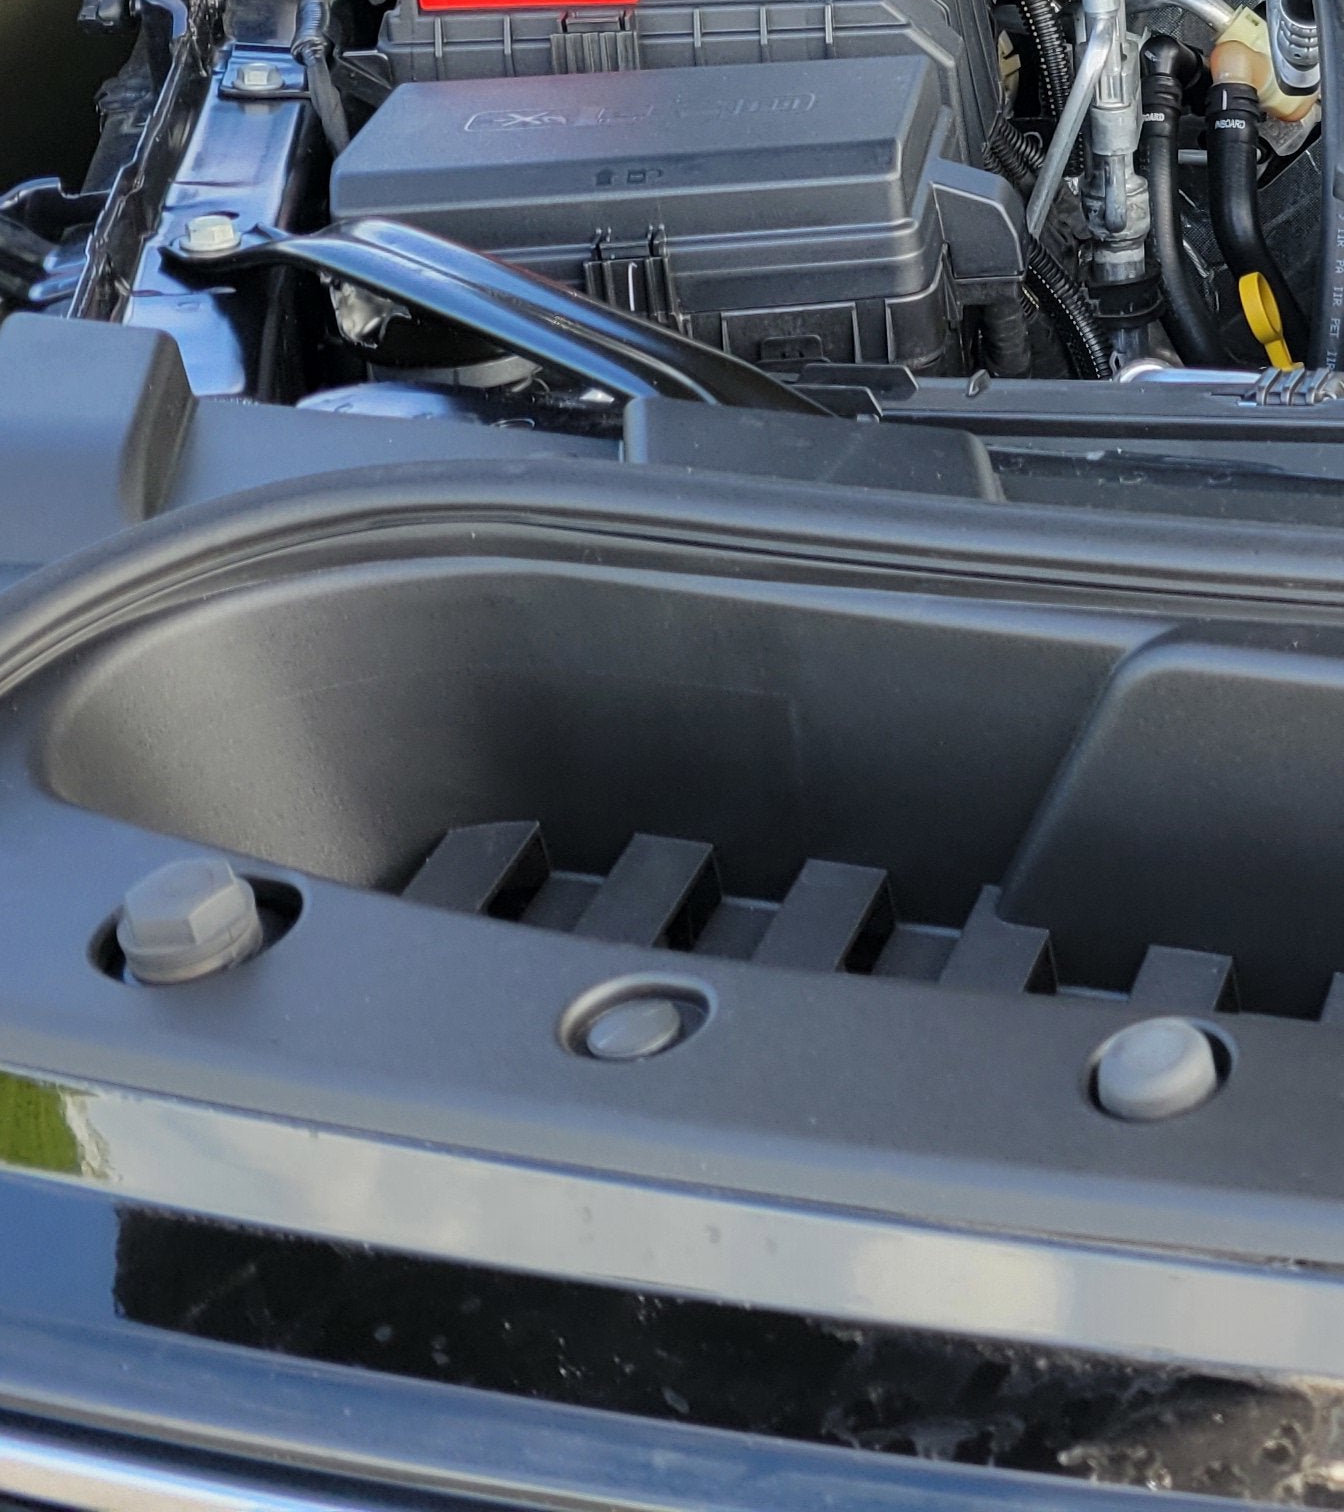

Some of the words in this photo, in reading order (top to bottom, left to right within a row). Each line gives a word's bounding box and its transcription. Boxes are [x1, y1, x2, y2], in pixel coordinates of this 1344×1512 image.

[1335, 259, 1344, 274] PA
[1332, 287, 1344, 307] IIR
[1329, 317, 1341, 338] PET
